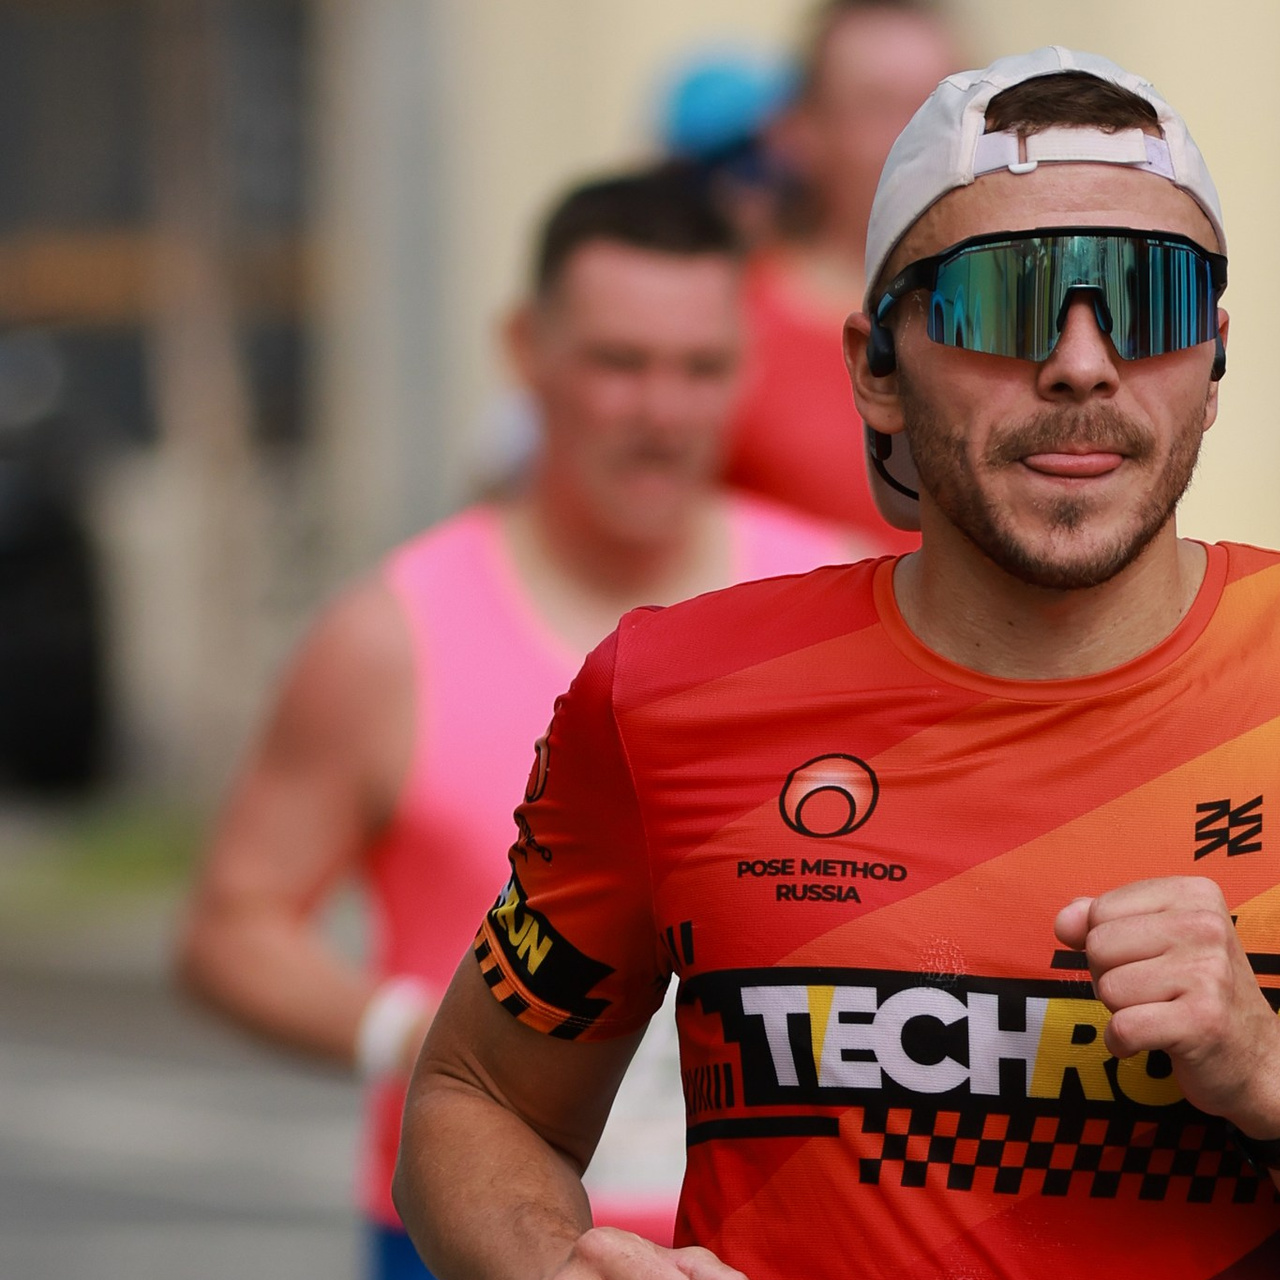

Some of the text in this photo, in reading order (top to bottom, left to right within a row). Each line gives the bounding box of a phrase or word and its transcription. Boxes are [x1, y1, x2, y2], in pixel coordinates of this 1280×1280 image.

[737, 859, 907, 882] POSE METHOD
[776, 884, 862, 903] RUSSIA
